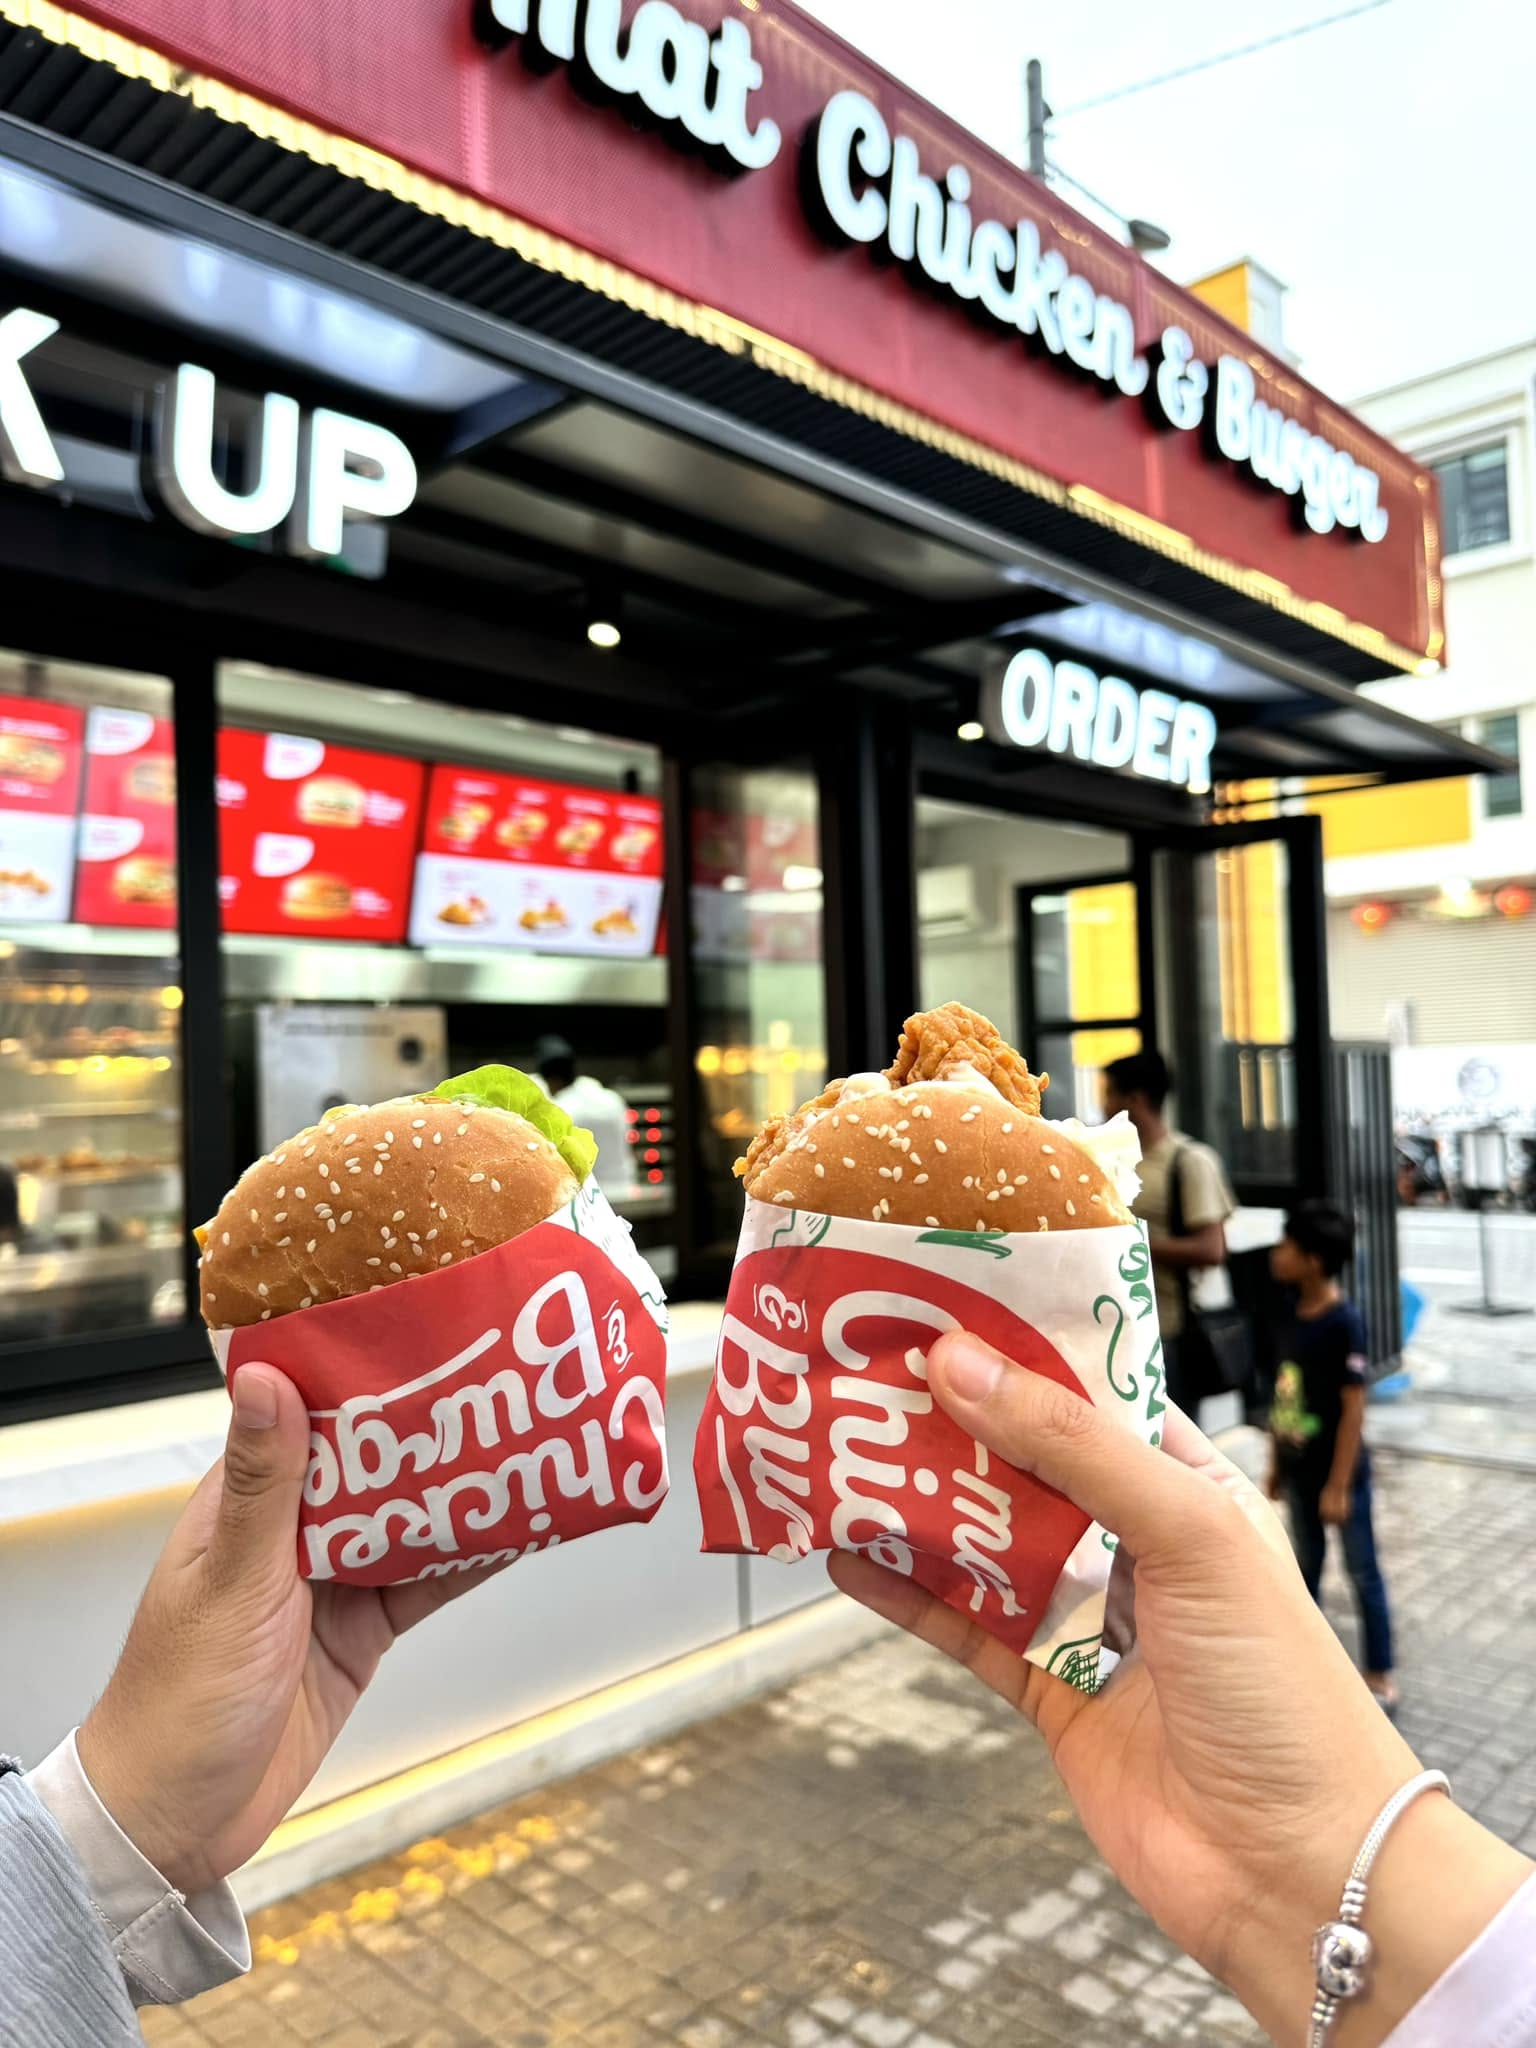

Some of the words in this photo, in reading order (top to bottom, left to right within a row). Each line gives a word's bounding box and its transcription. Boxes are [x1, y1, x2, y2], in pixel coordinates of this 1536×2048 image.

[817, 90, 1149, 396] Chicken
[1156, 326, 1209, 430] &
[1215, 353, 1389, 543] Burger
[173, 362, 418, 556] UP
[1001, 648, 1218, 788] ORDER
[302, 1270, 608, 1508] Burge
